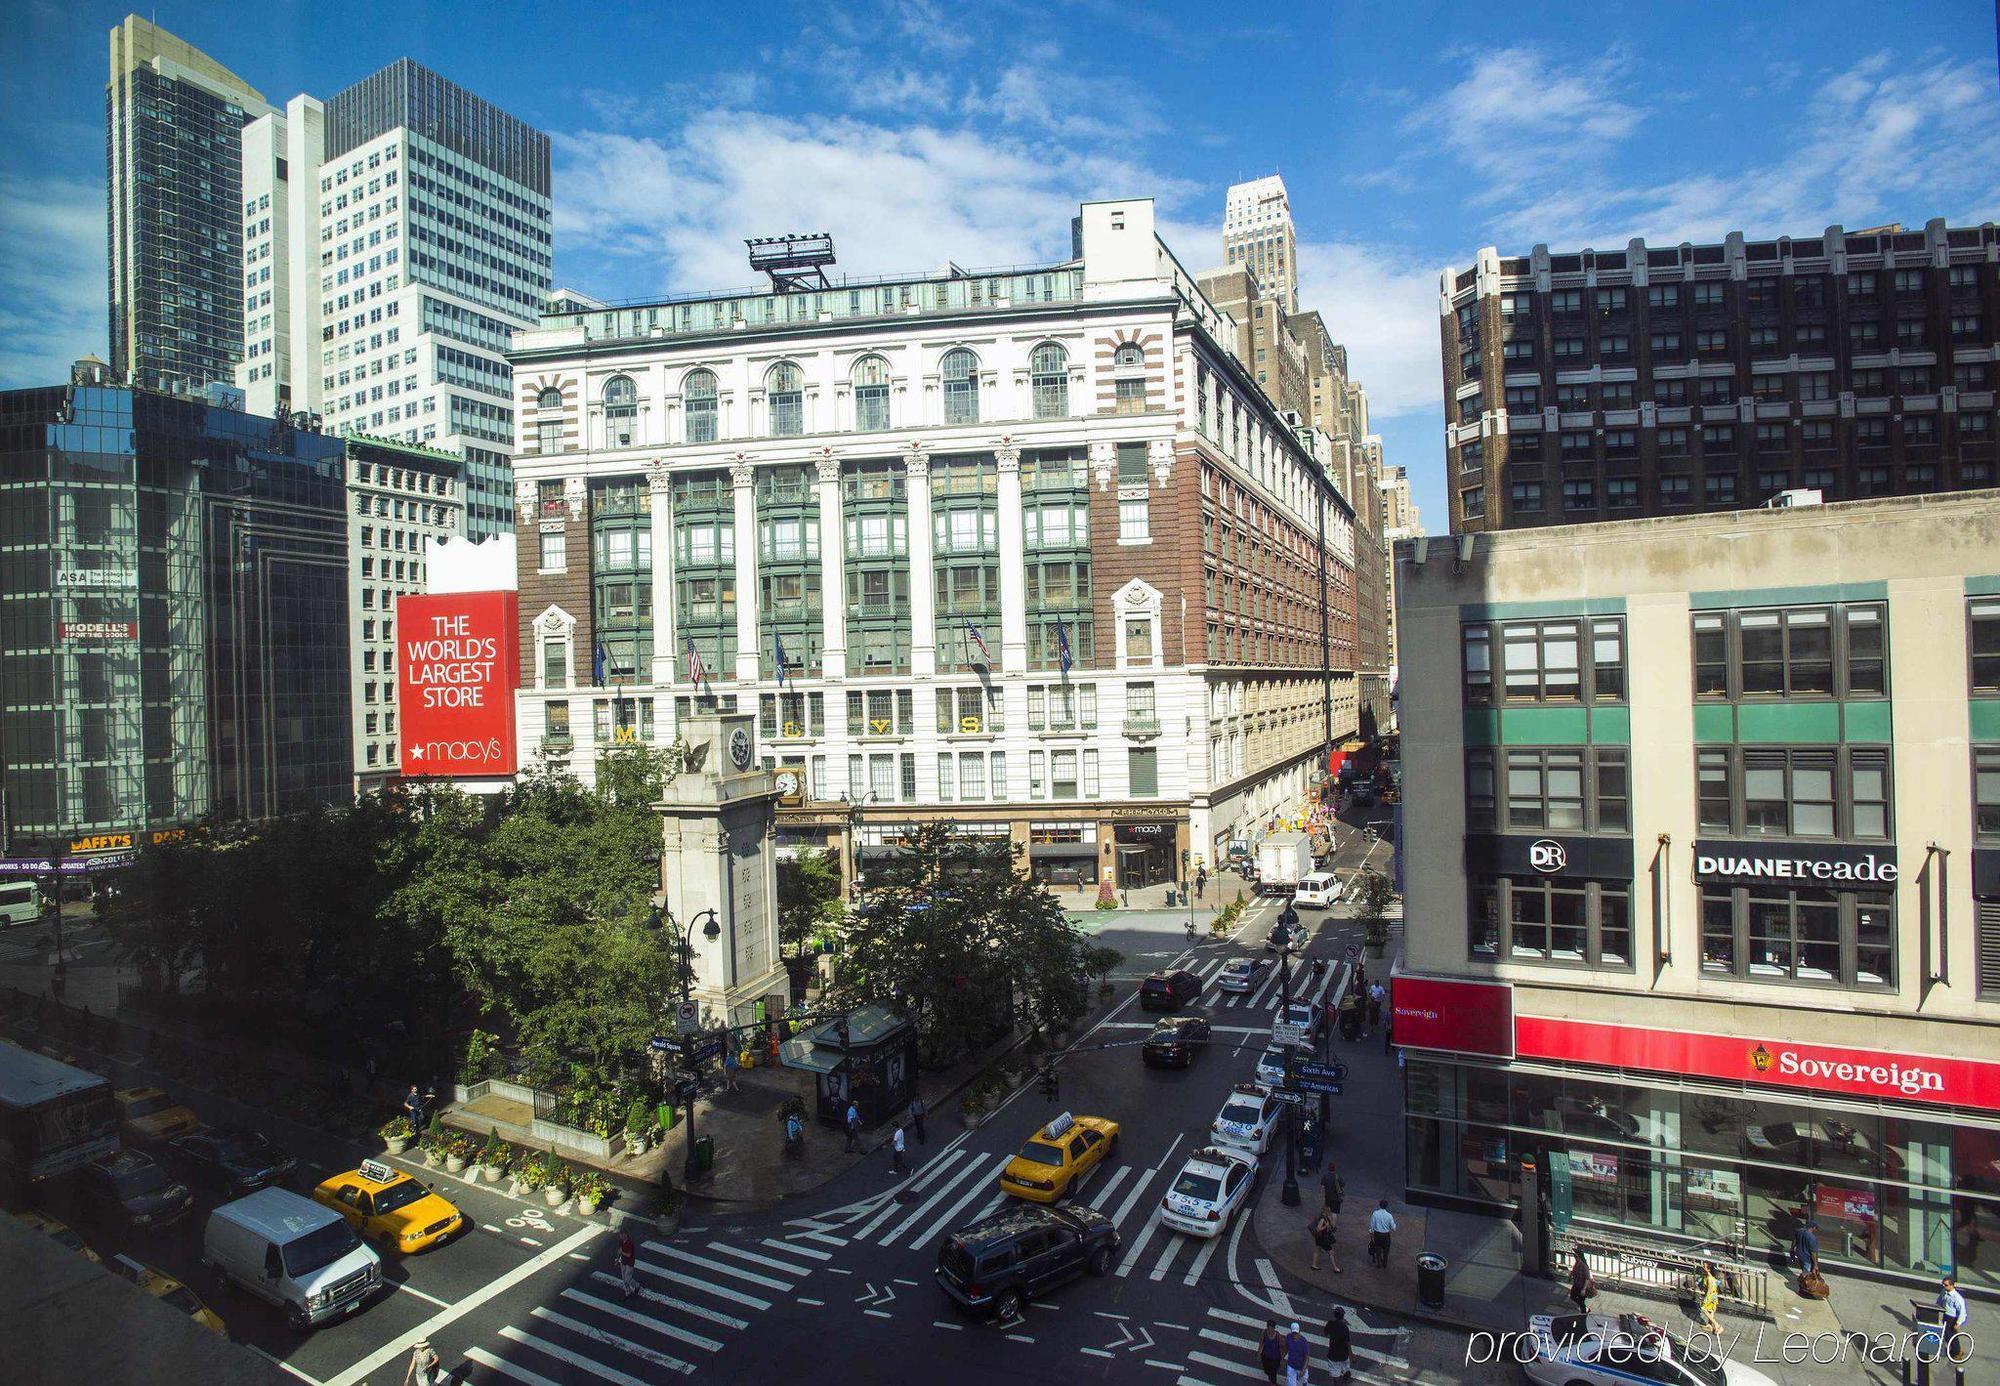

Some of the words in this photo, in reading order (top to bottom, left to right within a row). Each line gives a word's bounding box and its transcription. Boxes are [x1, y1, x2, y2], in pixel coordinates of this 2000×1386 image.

[60, 573, 87, 582] ASA
[65, 623, 129, 632] MODELL'S
[431, 615, 470, 637] THE
[407, 638, 497, 662] WORLD'S
[409, 662, 494, 685] LARGEST
[423, 686, 484, 708] STORE
[427, 738, 501, 764] macy's
[1135, 825, 1162, 833] macy's
[1698, 856, 1792, 877] DUANE
[1792, 855, 1898, 882] reade
[1394, 1007, 1438, 1020] Sovereign
[666, 1042, 681, 1051] Square
[1302, 1065, 1320, 1074] Sixth
[1321, 1067, 1335, 1077] Ave
[1779, 1051, 1945, 1094] Sovereign
[1169, 1193, 1213, 1211] 4552
[1620, 1254, 1658, 1268] Subway
